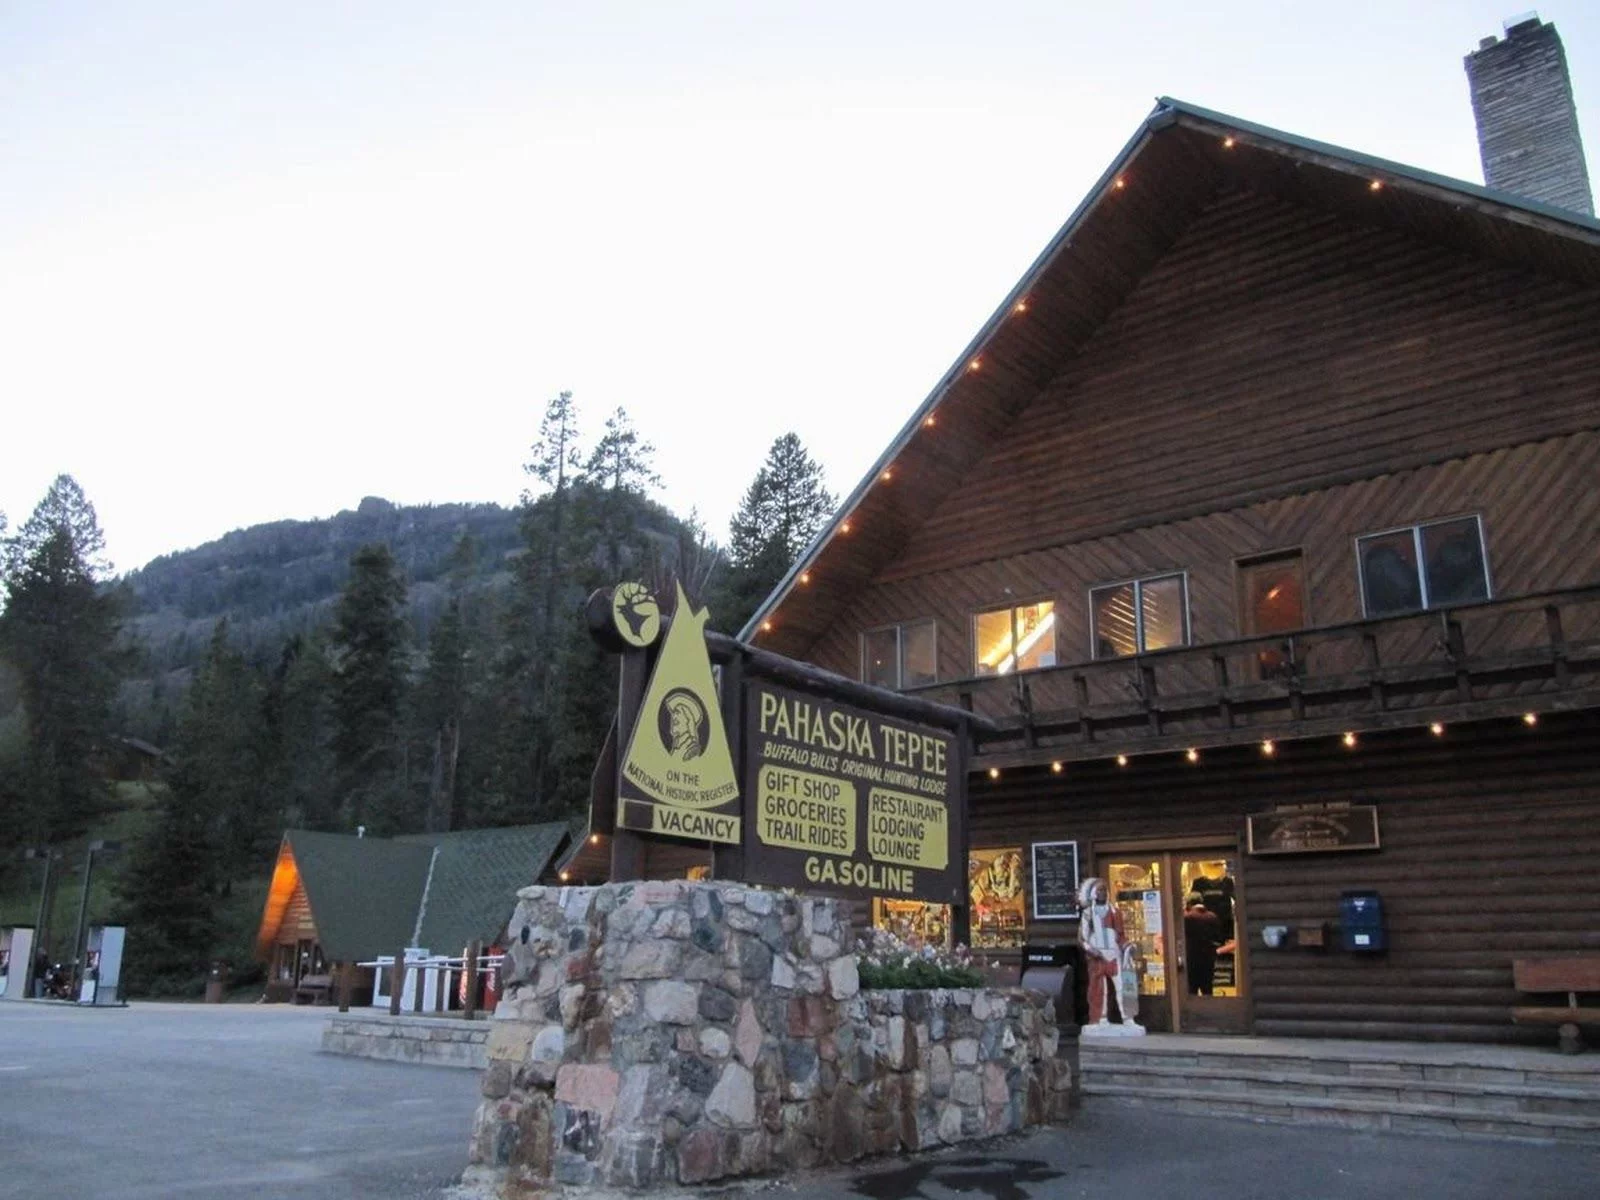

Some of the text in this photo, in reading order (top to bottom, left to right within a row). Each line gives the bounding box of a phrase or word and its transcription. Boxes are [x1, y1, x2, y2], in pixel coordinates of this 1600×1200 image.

[760, 691, 947, 776] PAHASKA TEPEE
[626, 761, 736, 802] NATIONAL HISTORIC REGISTER
[666, 769, 699, 786] ON THE
[763, 741, 947, 796] BUFFALO BILL'S ORIGINAL HUNTING LODGE
[766, 771, 841, 802] GIFT SHOP
[658, 809, 735, 839] VACANCY
[765, 795, 847, 827] GROCERIES
[872, 793, 943, 824] RESTAURANT
[765, 818, 848, 850] TRAIL RIDES
[872, 814, 925, 842] LODGING
[872, 837, 921, 861] LOUNGE
[805, 856, 915, 894] GASOLINE
